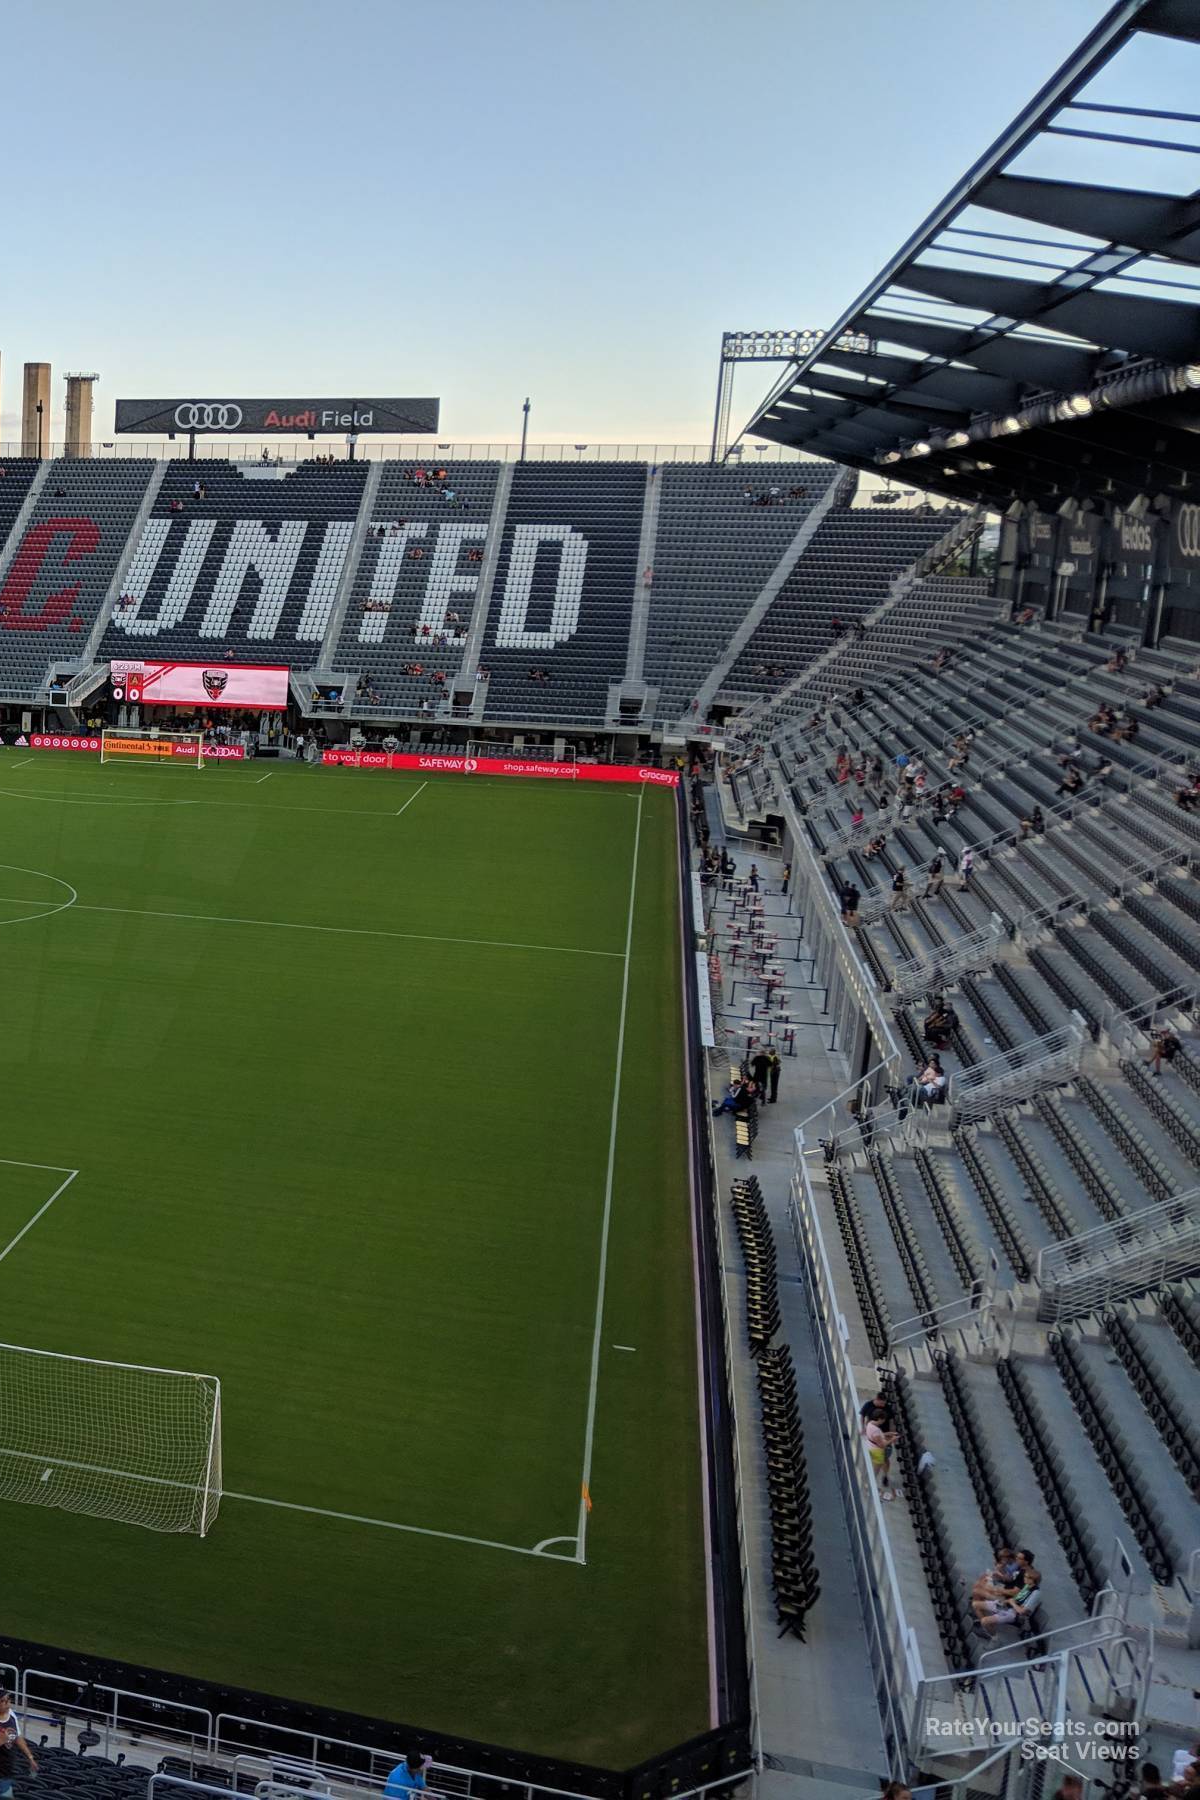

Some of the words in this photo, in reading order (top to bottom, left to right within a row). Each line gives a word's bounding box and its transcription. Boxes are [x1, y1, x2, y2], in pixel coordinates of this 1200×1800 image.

[263, 410, 316, 427] Audi
[321, 410, 374, 427] Field
[111, 518, 589, 650] UNITED
[113, 687, 124, 700] 0
[129, 688, 140, 701] 0
[175, 745, 196, 754] Audi
[328, 753, 339, 761] to
[362, 754, 386, 764] door
[418, 757, 464, 769] SAFEWAY
[503, 762, 580, 775] shop.safeway.com
[638, 769, 674, 784] Grocery
